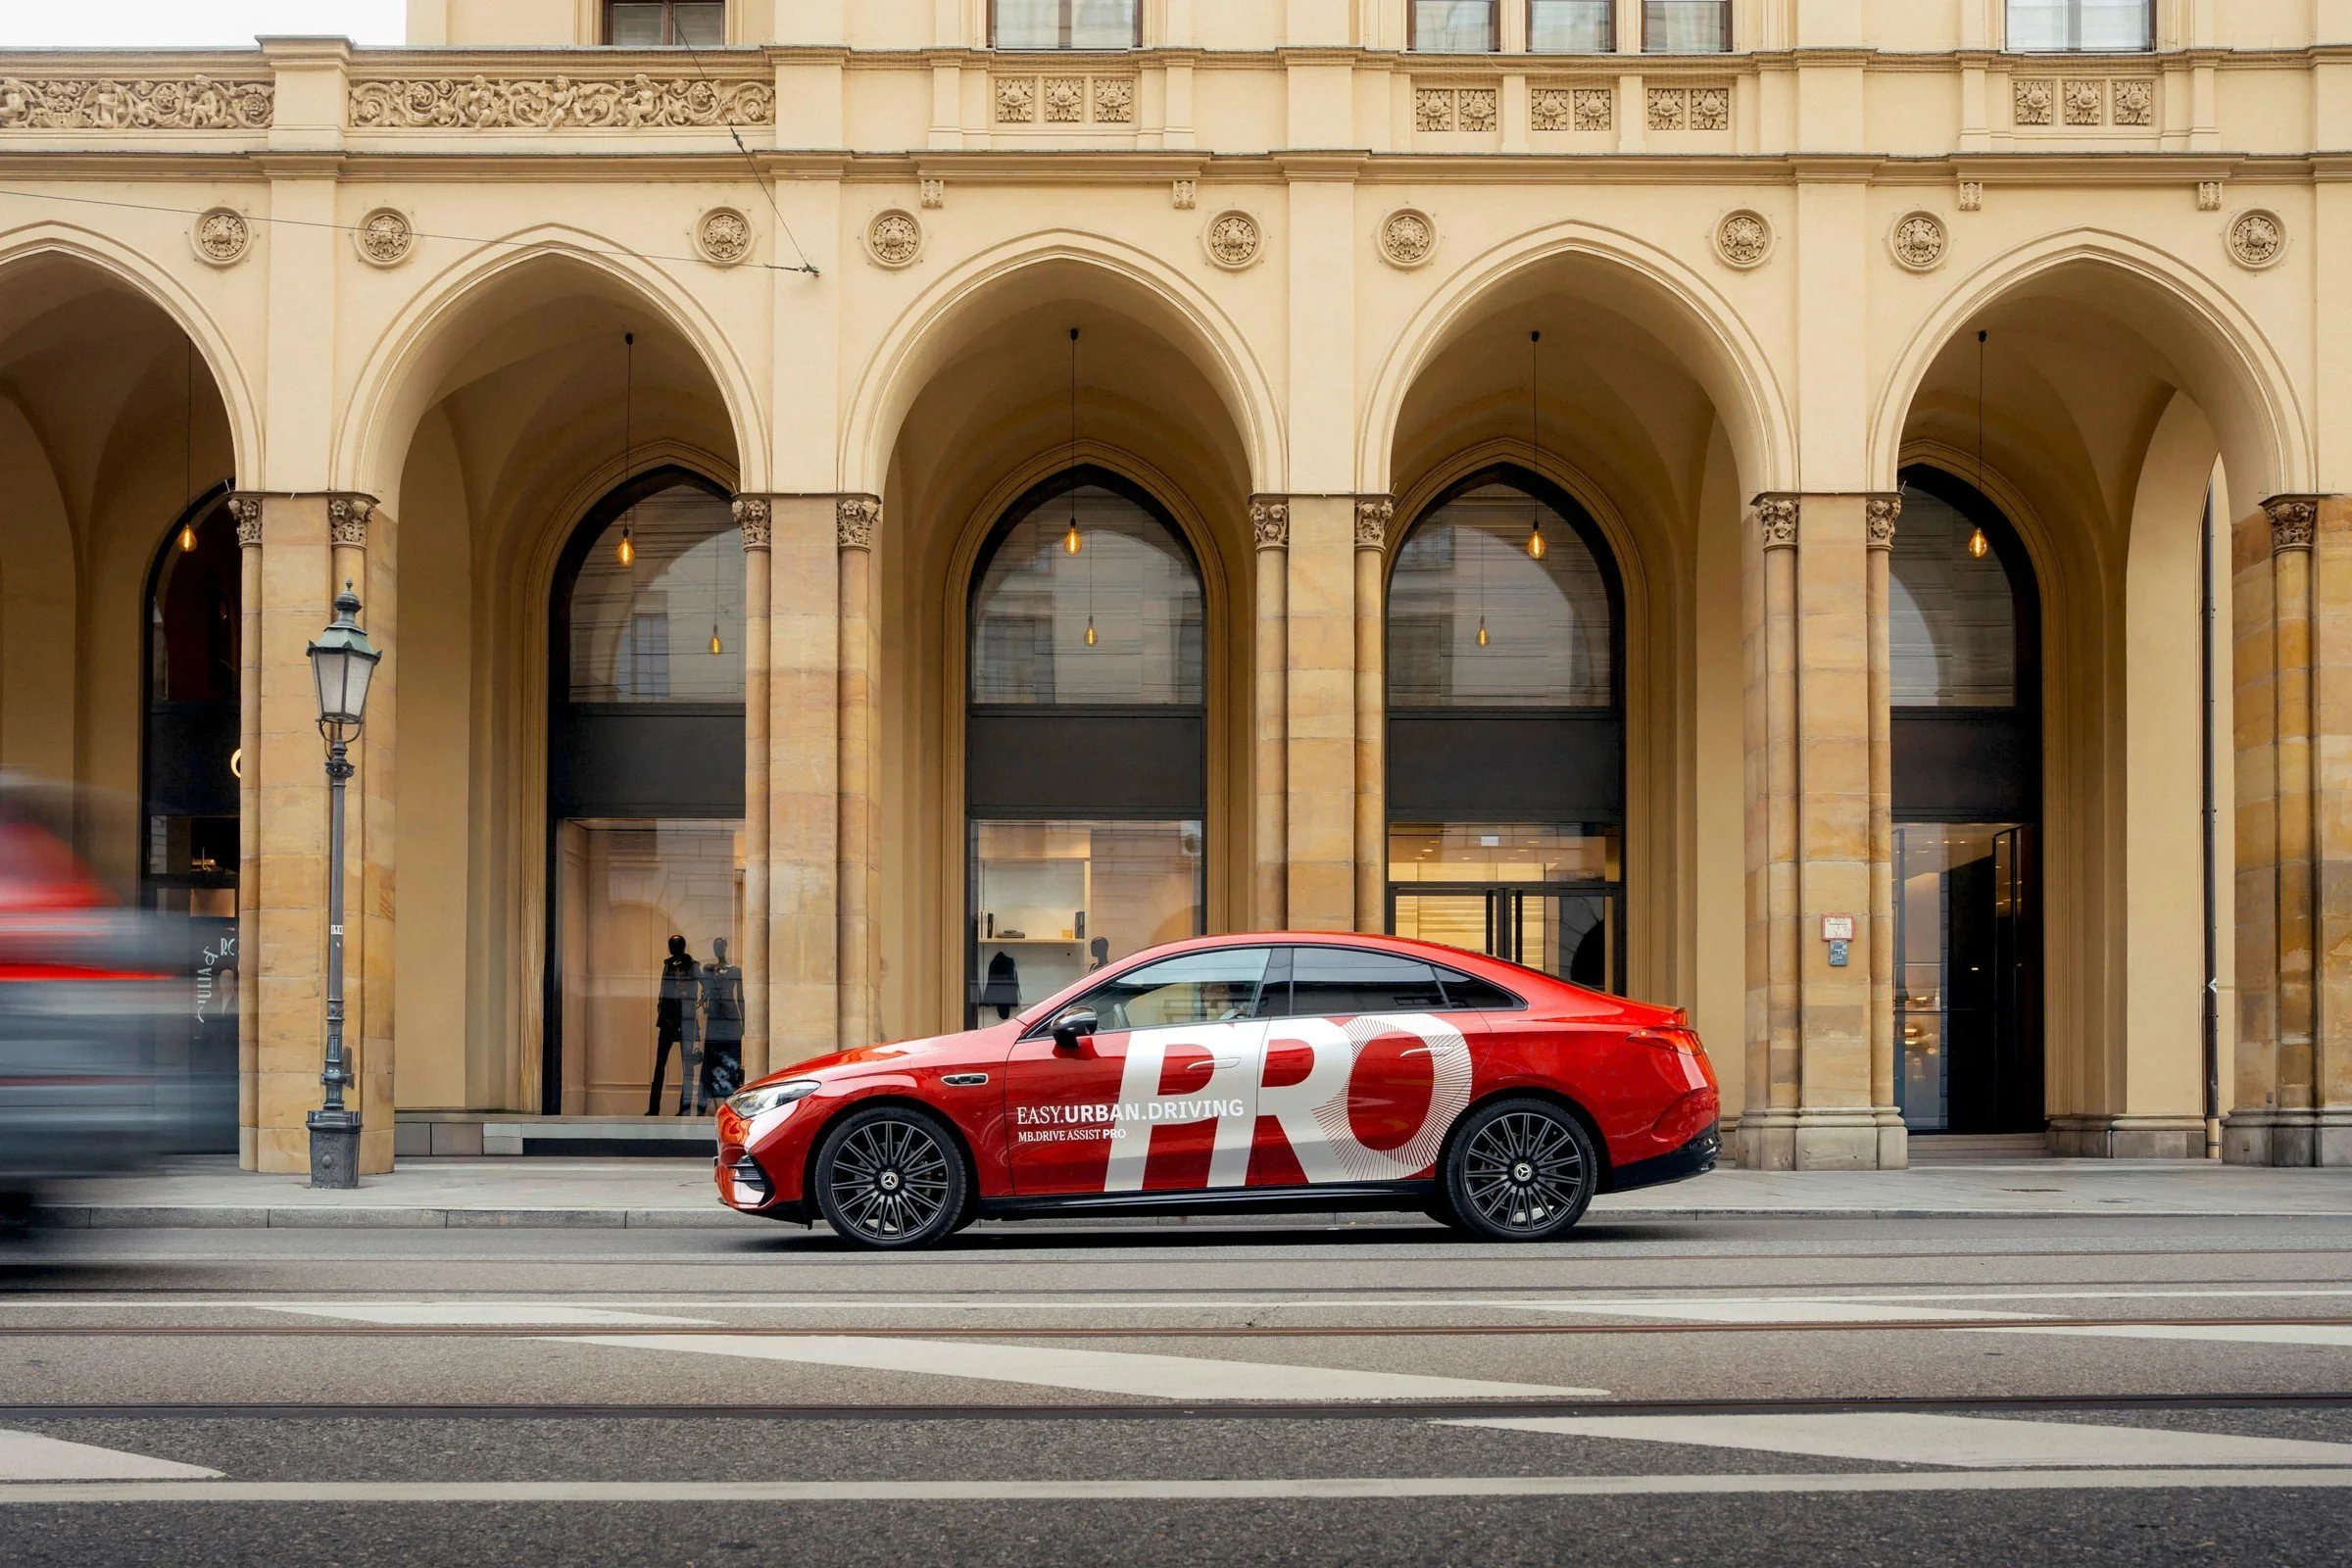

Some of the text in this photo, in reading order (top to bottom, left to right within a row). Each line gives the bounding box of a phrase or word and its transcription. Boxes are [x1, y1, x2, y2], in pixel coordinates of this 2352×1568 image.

[1016, 1099, 1244, 1125] EASY.URBAN.DRIVING
[1103, 1013, 1472, 1193] PRO
[1018, 1128, 1126, 1143] MB.DRIVE ASSIST PRO
